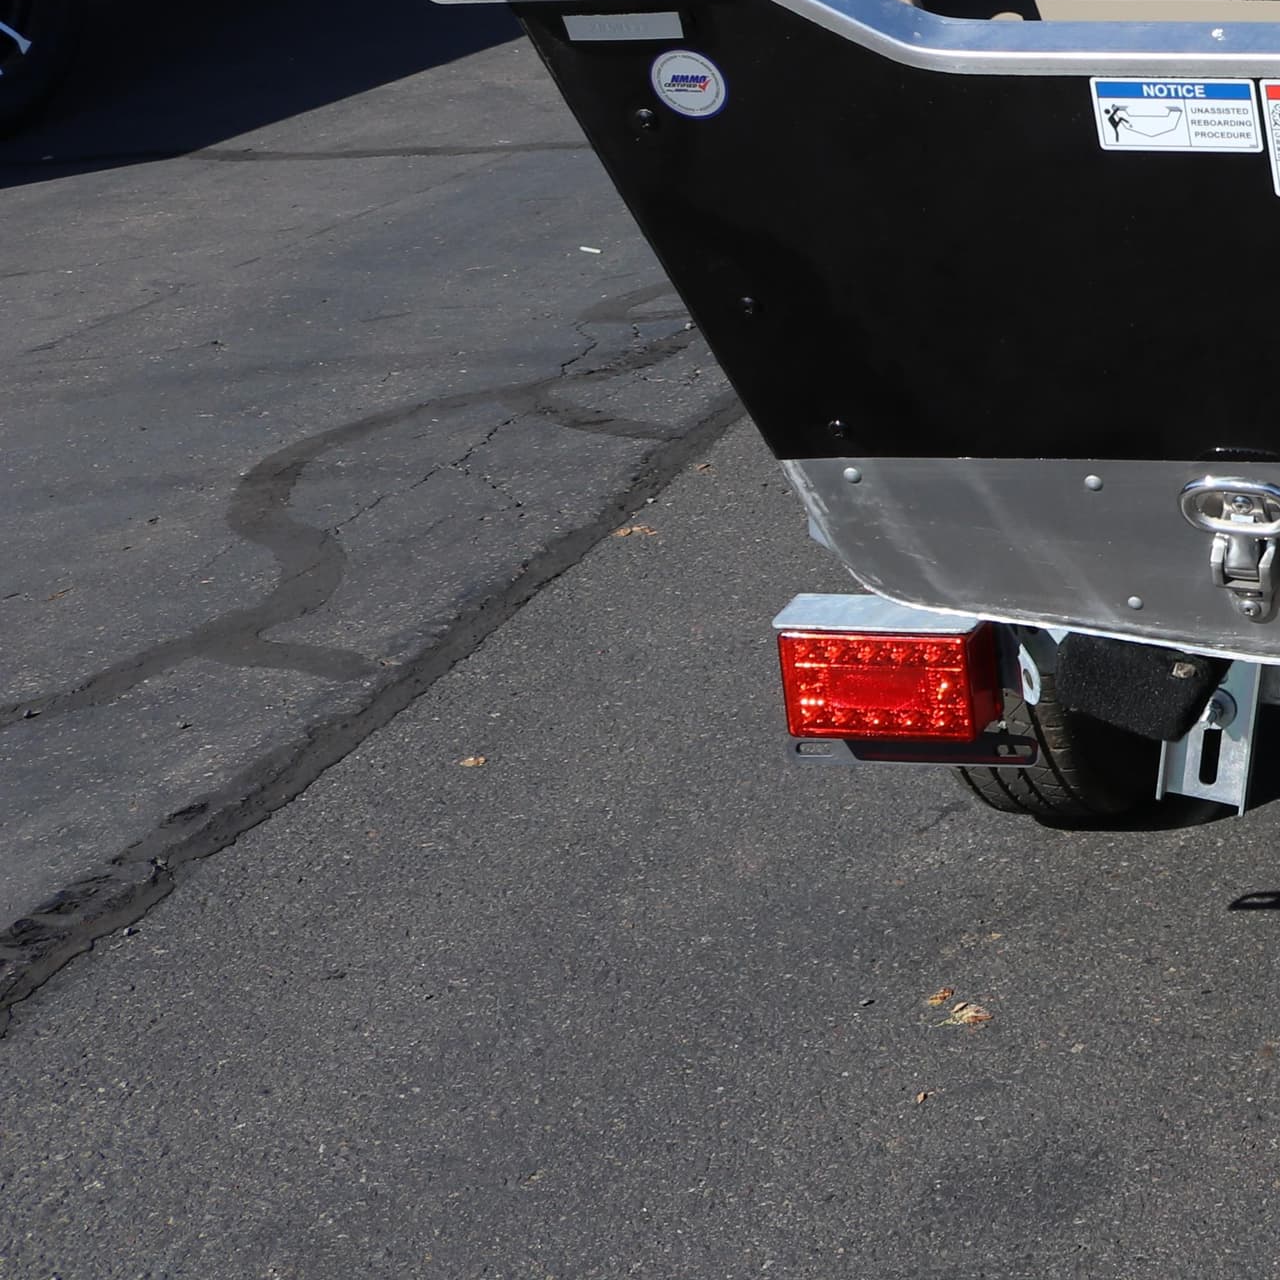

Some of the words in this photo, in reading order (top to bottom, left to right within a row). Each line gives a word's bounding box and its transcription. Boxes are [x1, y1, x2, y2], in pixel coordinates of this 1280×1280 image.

[1142, 84, 1206, 97] NOTICE
[1190, 107, 1249, 115] UNASSISTED
[1190, 119, 1252, 127] REBOARDING
[1194, 131, 1252, 139] PROCEDURE
